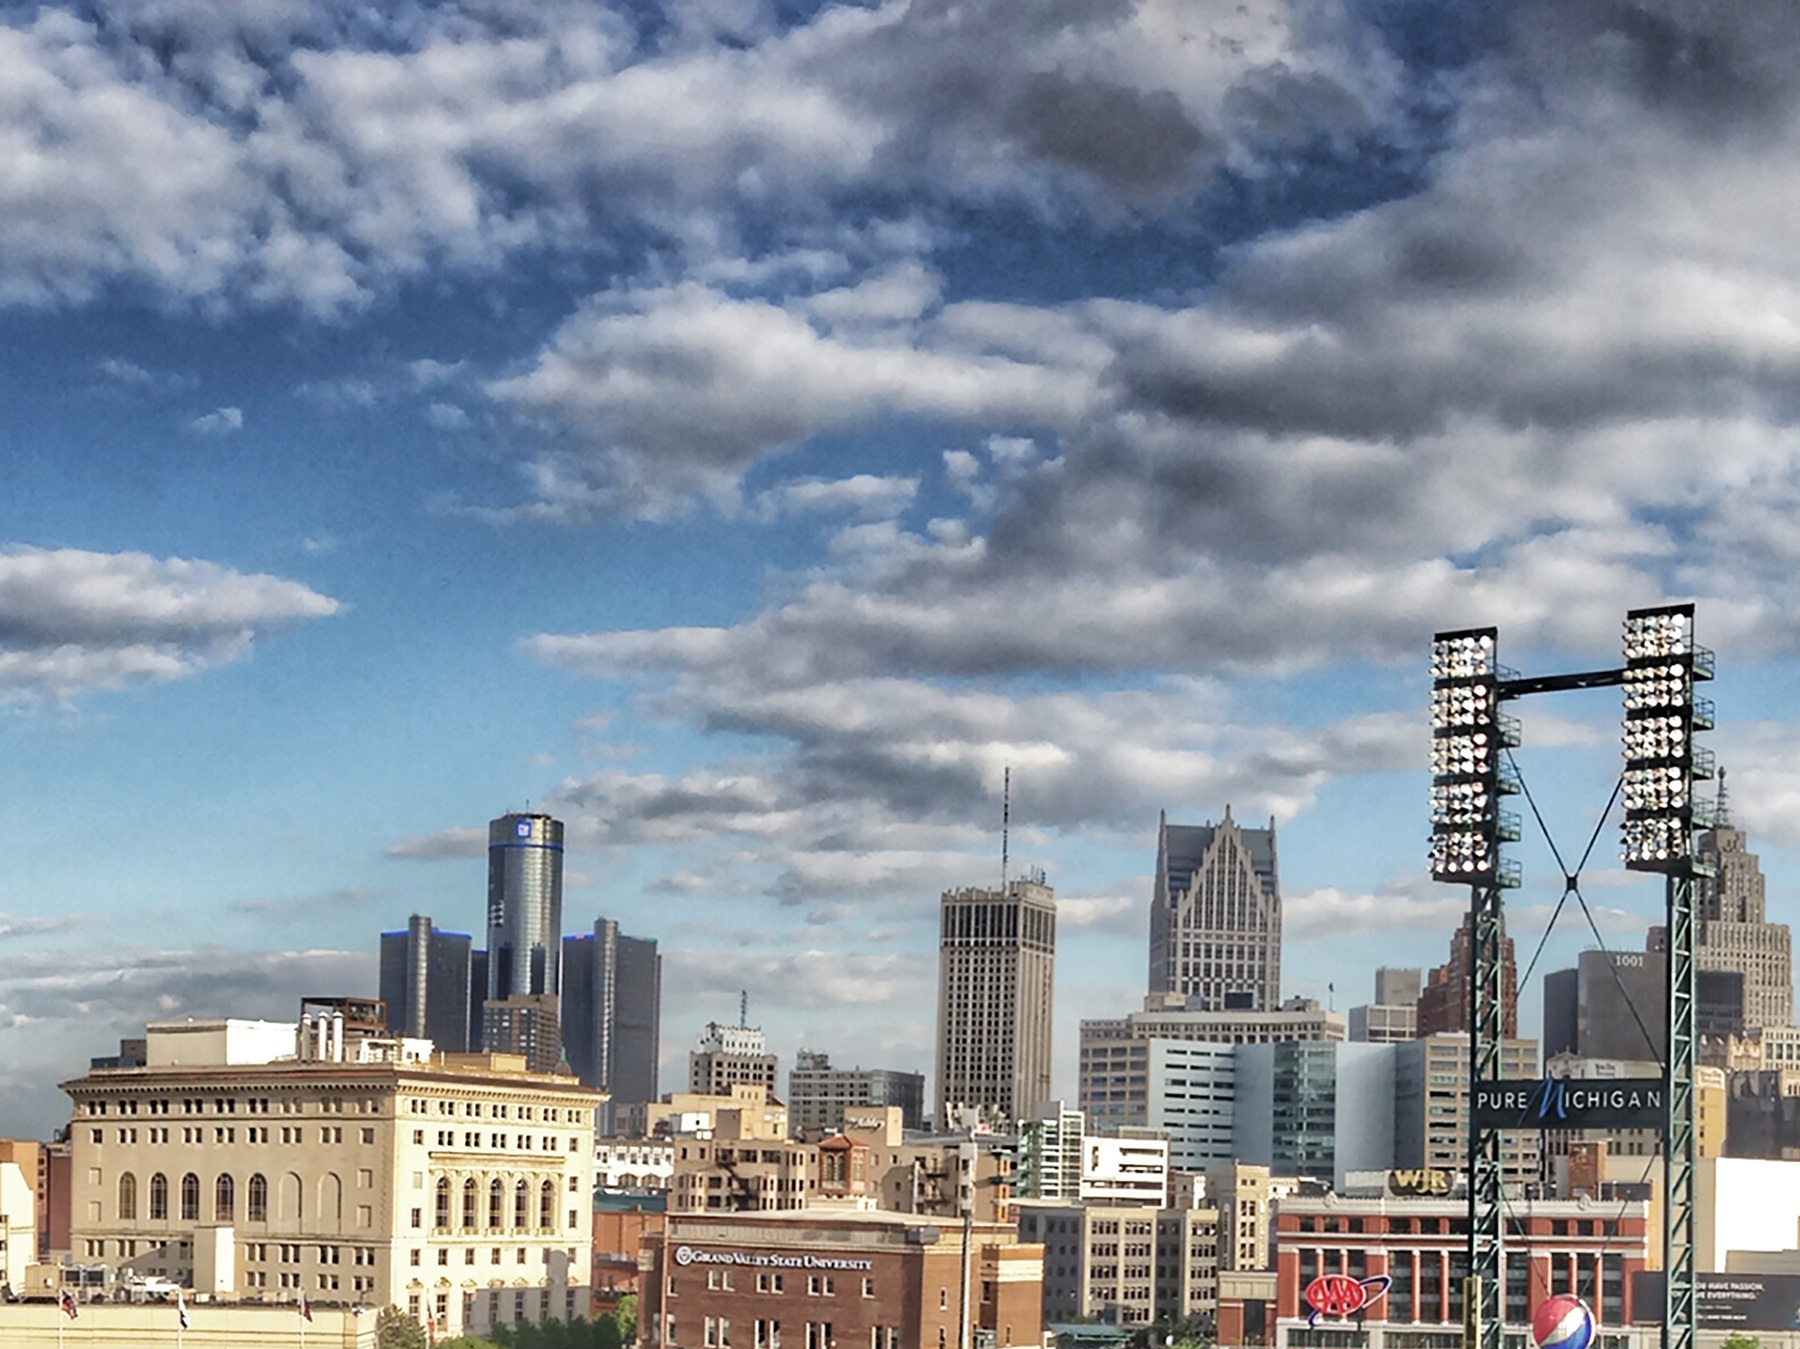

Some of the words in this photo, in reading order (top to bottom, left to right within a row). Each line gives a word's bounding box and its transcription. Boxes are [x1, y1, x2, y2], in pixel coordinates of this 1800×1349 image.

[1615, 955, 1644, 967] 1001
[1477, 1092, 1528, 1109] PURE
[1517, 1077, 1661, 1127] MICHIGAN
[1393, 1169, 1447, 1194] WJR
[692, 1250, 733, 1265] GRAND
[733, 1252, 769, 1266] VALLEY
[770, 1253, 803, 1267] STATE
[803, 1255, 873, 1270] UNIVERSITY
[1311, 1277, 1362, 1311] AAA
